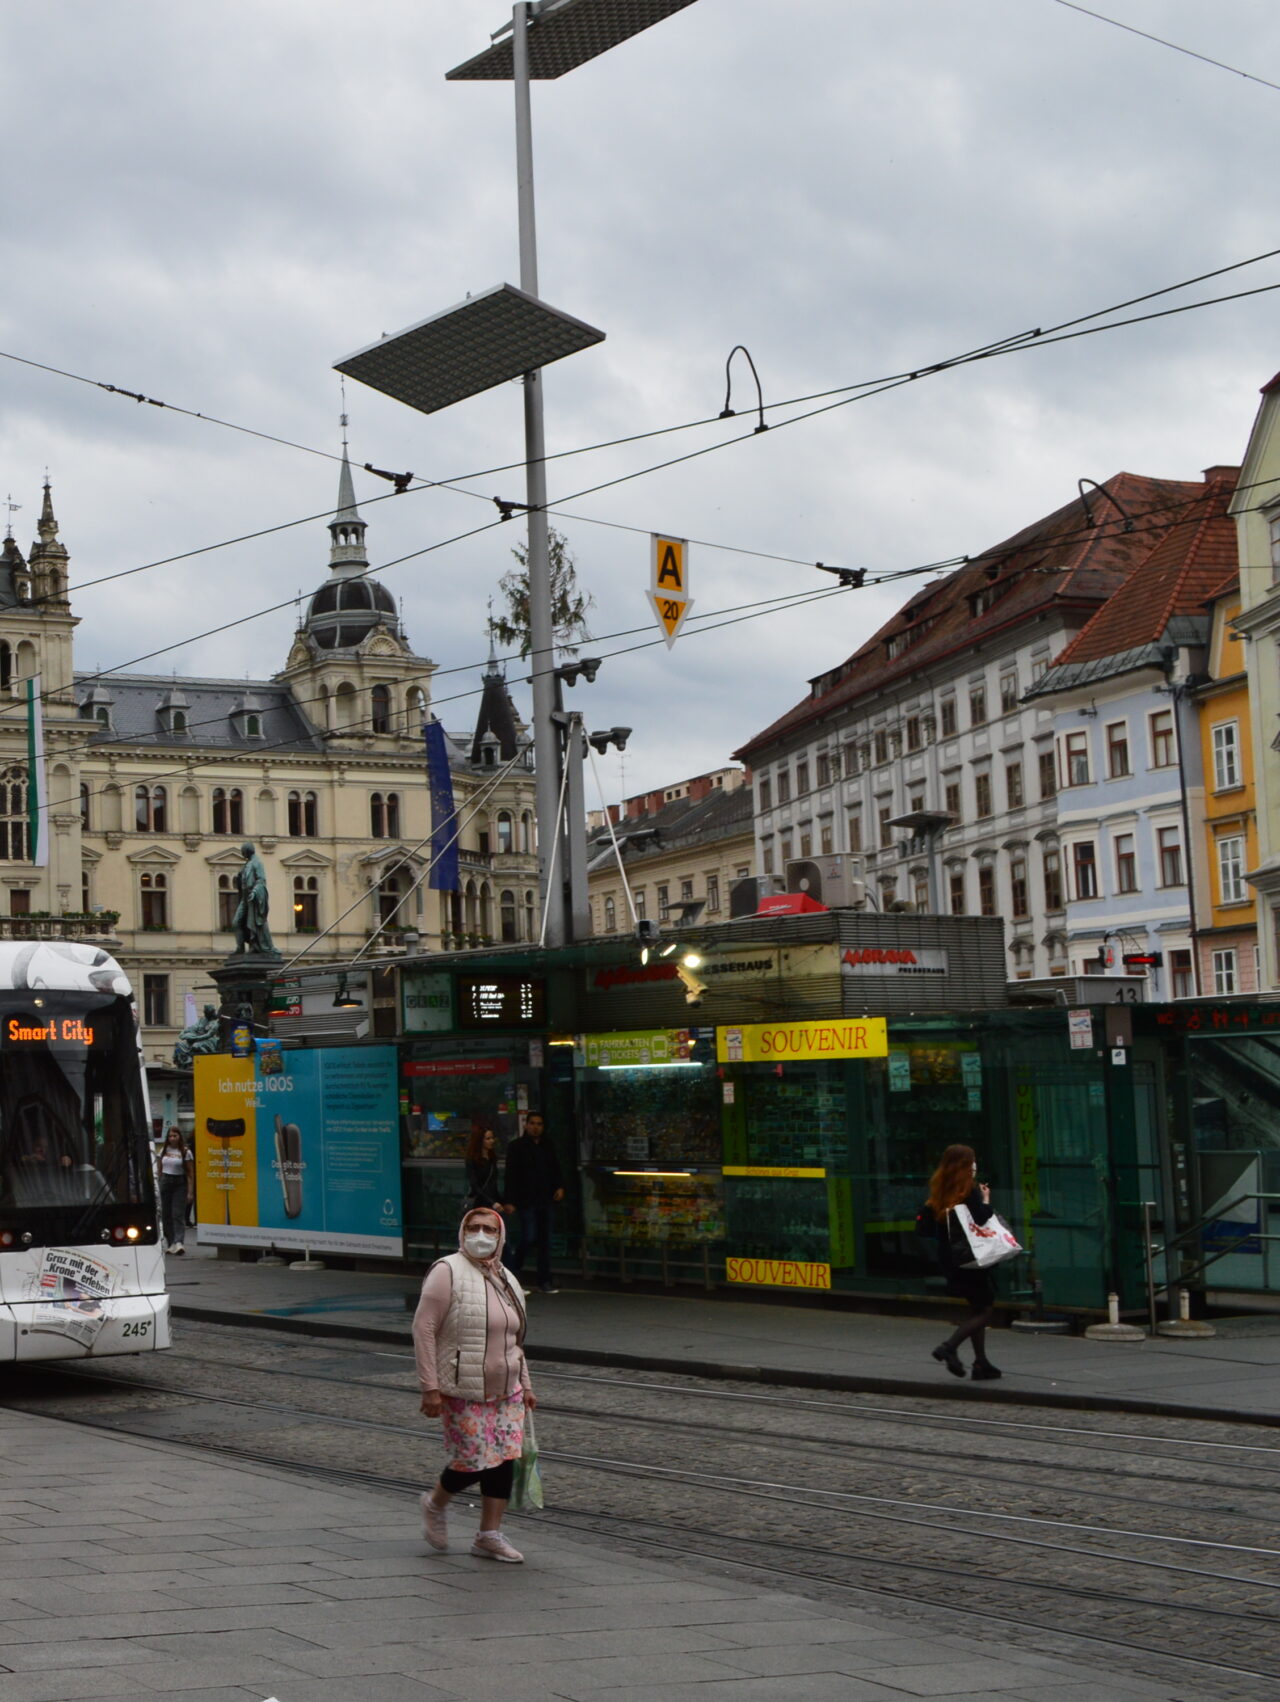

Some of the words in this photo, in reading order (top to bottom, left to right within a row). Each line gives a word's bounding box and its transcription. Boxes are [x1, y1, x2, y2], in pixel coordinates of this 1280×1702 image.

[658, 545, 682, 587] A
[663, 600, 679, 621] 20
[700, 960, 773, 975] ESSEHAUS
[8, 1019, 57, 1041] Smart
[62, 1019, 94, 1045] City
[760, 1026, 868, 1054] SOUVENIR
[219, 1079, 234, 1093] Ich
[235, 1079, 264, 1093] nutze
[265, 1076, 295, 1092] IQOS
[46, 1252, 68, 1265] Graz
[69, 1258, 85, 1270] mit
[85, 1264, 99, 1278] der
[728, 1259, 829, 1288] SOUVENIR
[81, 1274, 111, 1296] erleben
[121, 1321, 149, 1337] 245
